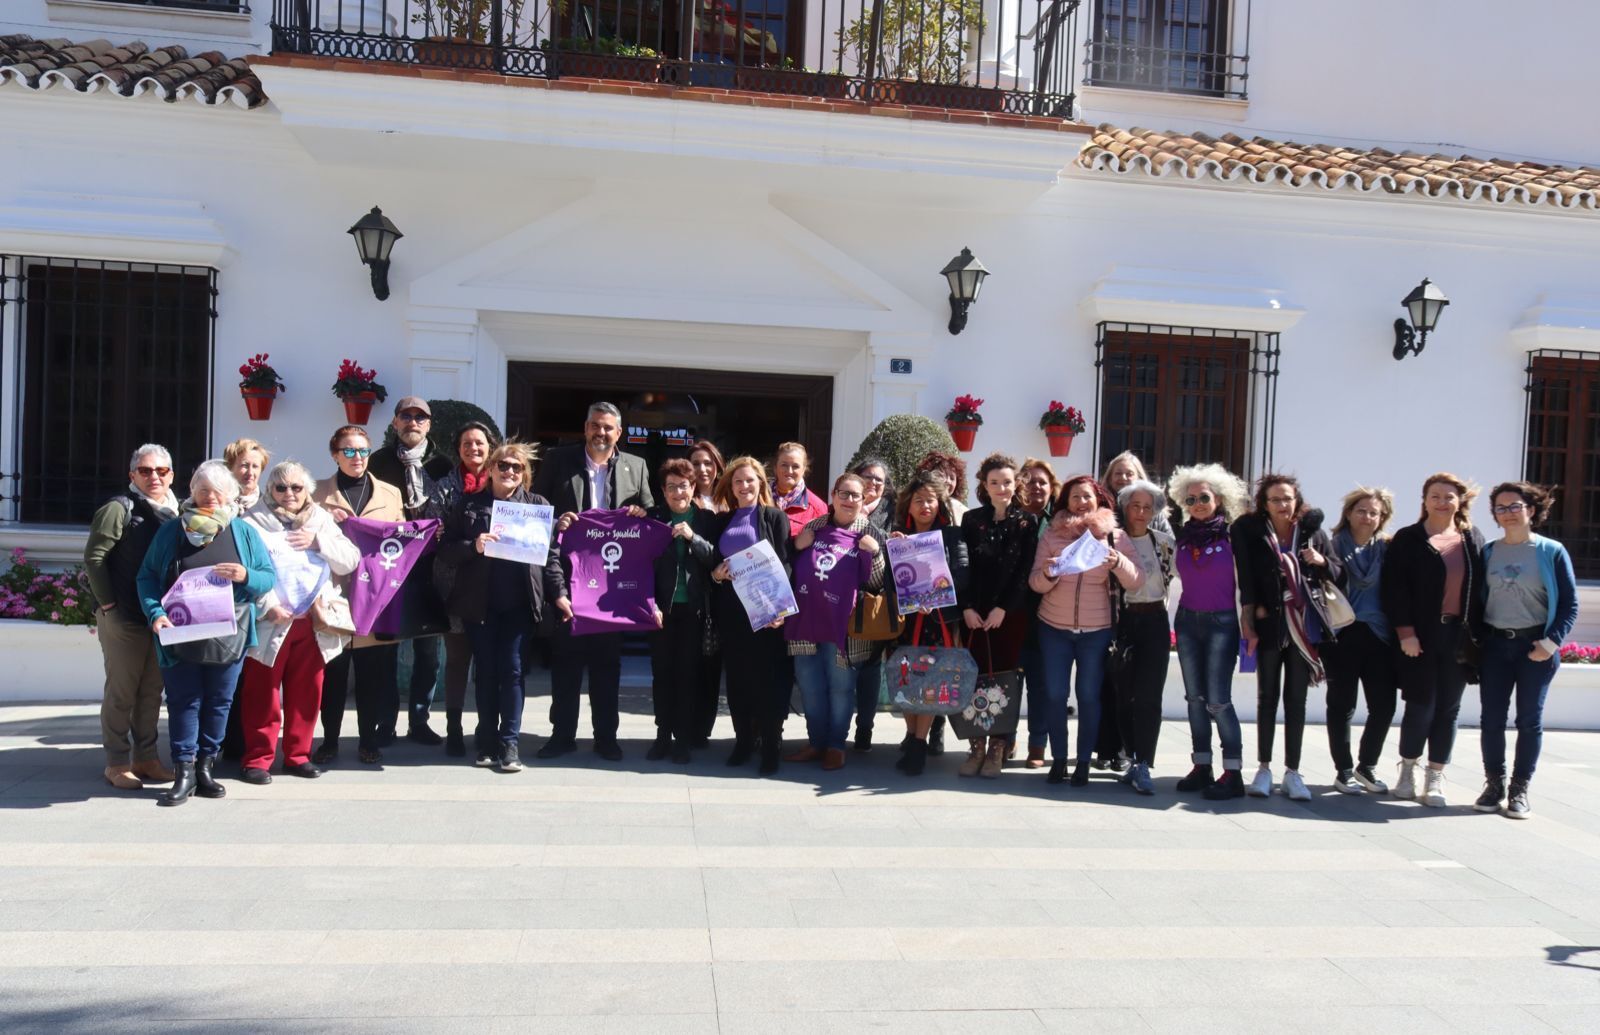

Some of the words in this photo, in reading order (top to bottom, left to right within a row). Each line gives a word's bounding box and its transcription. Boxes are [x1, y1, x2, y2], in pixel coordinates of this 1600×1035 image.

[898, 361, 905, 372] 2
[496, 506, 515, 517] Mijas
[523, 509, 551, 520] Igualdad
[586, 528, 605, 540] Mijas
[612, 528, 640, 540] Igualdad
[813, 540, 827, 549] Mijas
[891, 544, 908, 556] Mijas
[913, 538, 940, 552] Igualdad
